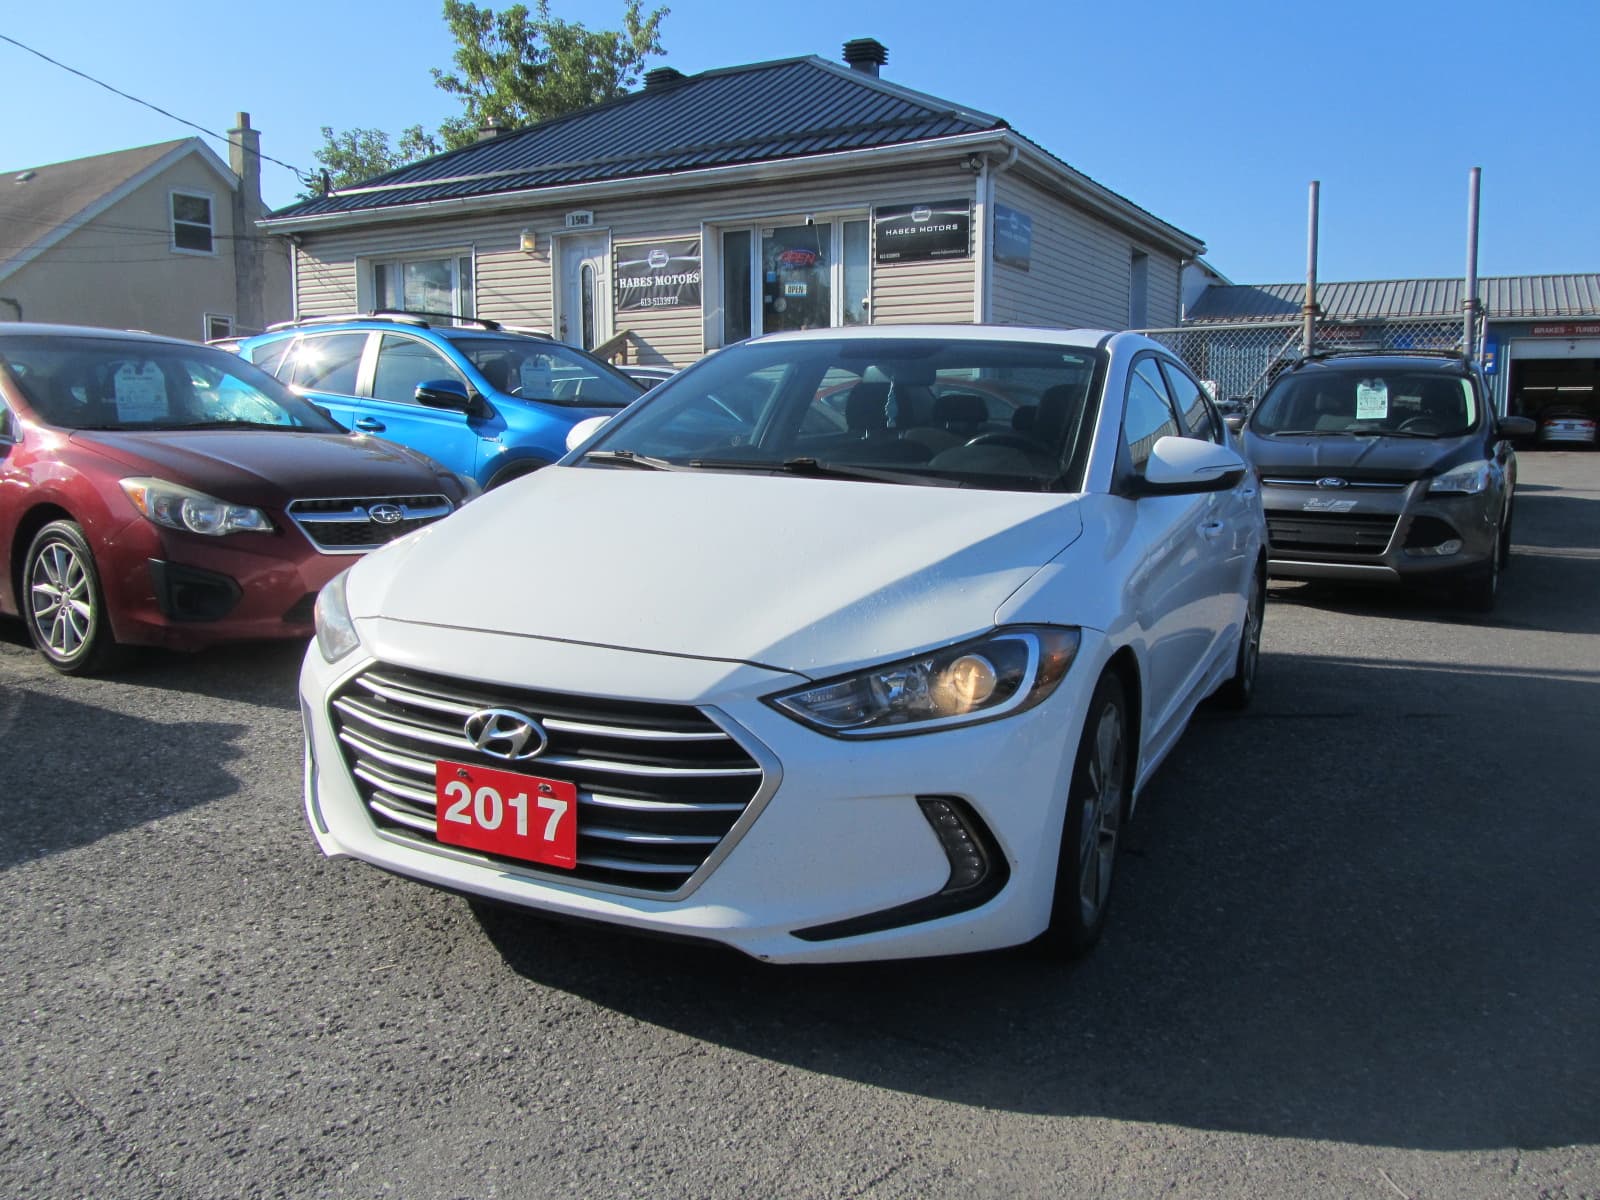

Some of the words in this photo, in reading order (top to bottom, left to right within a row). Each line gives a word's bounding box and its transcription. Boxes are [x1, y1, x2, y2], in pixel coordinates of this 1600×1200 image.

[885, 227, 916, 236] HABES
[919, 223, 958, 233] MOTORS
[619, 276, 653, 289] HABES
[655, 272, 700, 286] MOTORS
[444, 780, 568, 842] 2017
